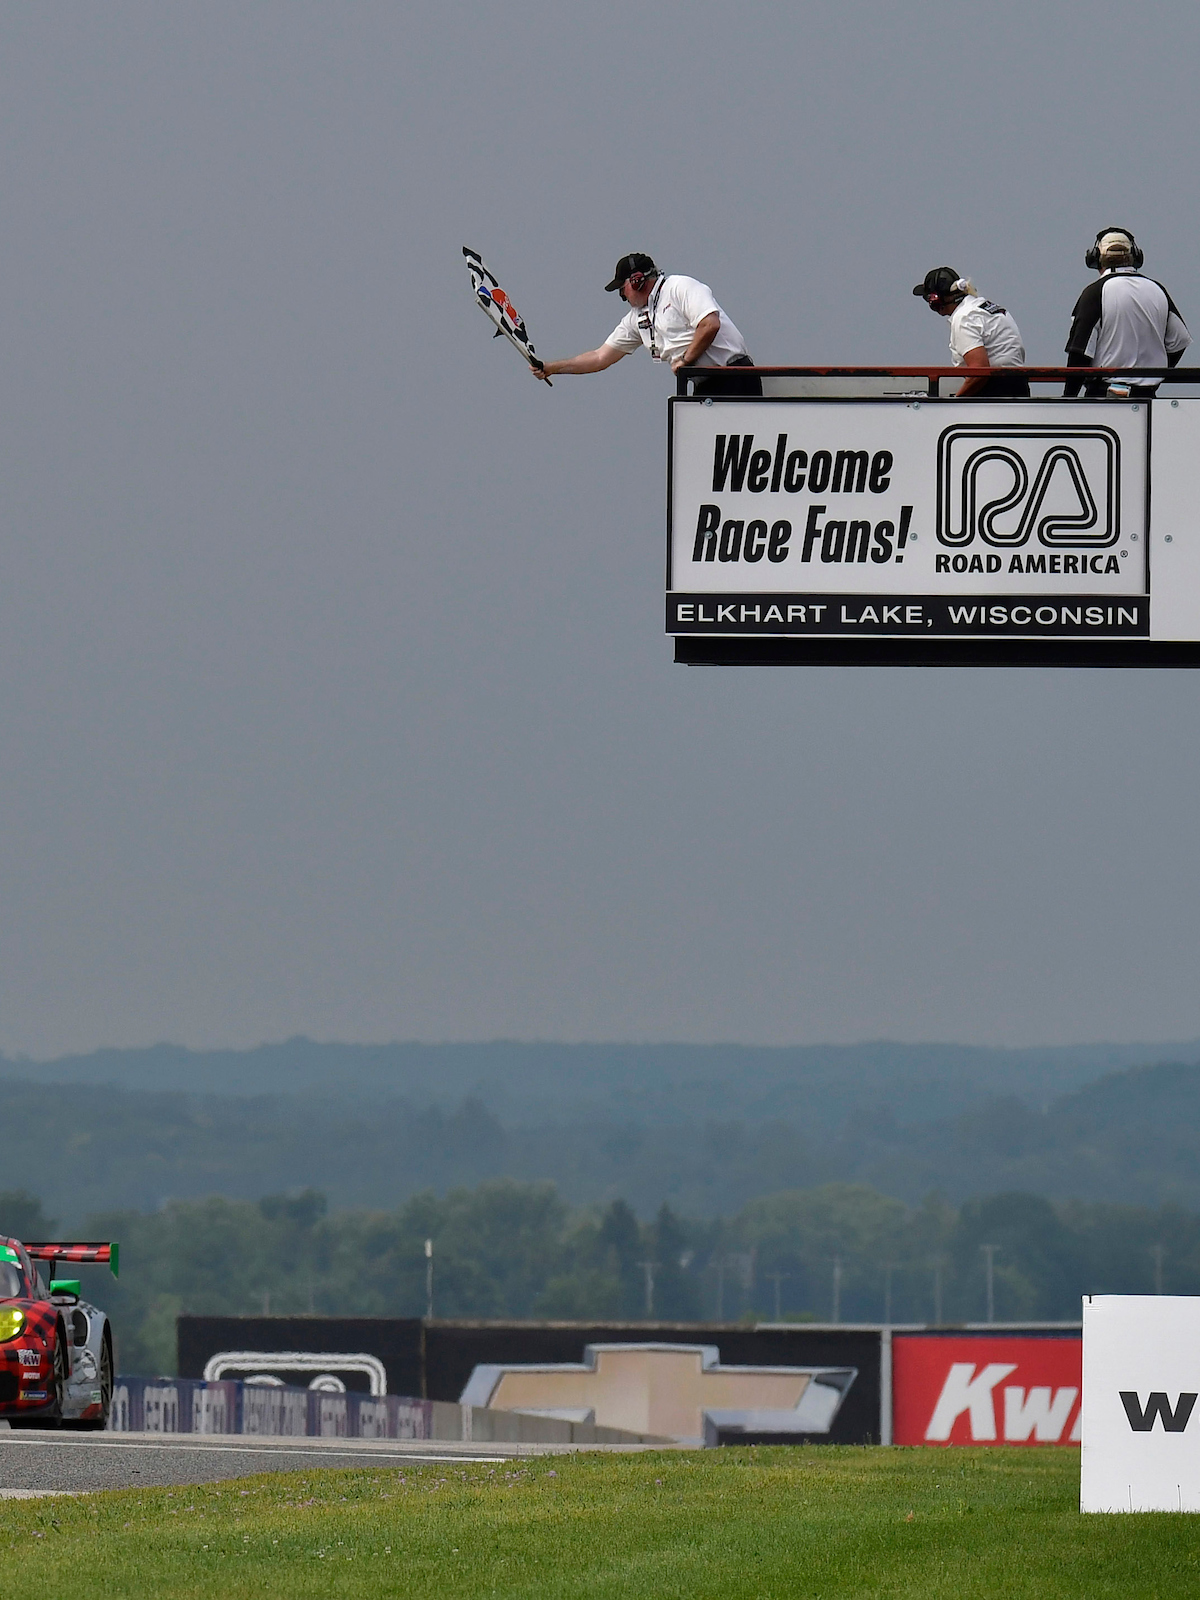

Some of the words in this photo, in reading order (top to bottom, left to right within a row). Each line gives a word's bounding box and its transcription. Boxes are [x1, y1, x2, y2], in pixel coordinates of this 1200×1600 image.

[712, 433, 894, 494] Welcome
[692, 504, 792, 563] Race
[801, 505, 914, 563] Fans!
[935, 554, 1002, 574] ROAD
[1008, 554, 1121, 574] AMERICA
[676, 603, 828, 624] ELKHART
[840, 604, 933, 628] LAKE,
[948, 605, 1139, 626] WISCONSIN
